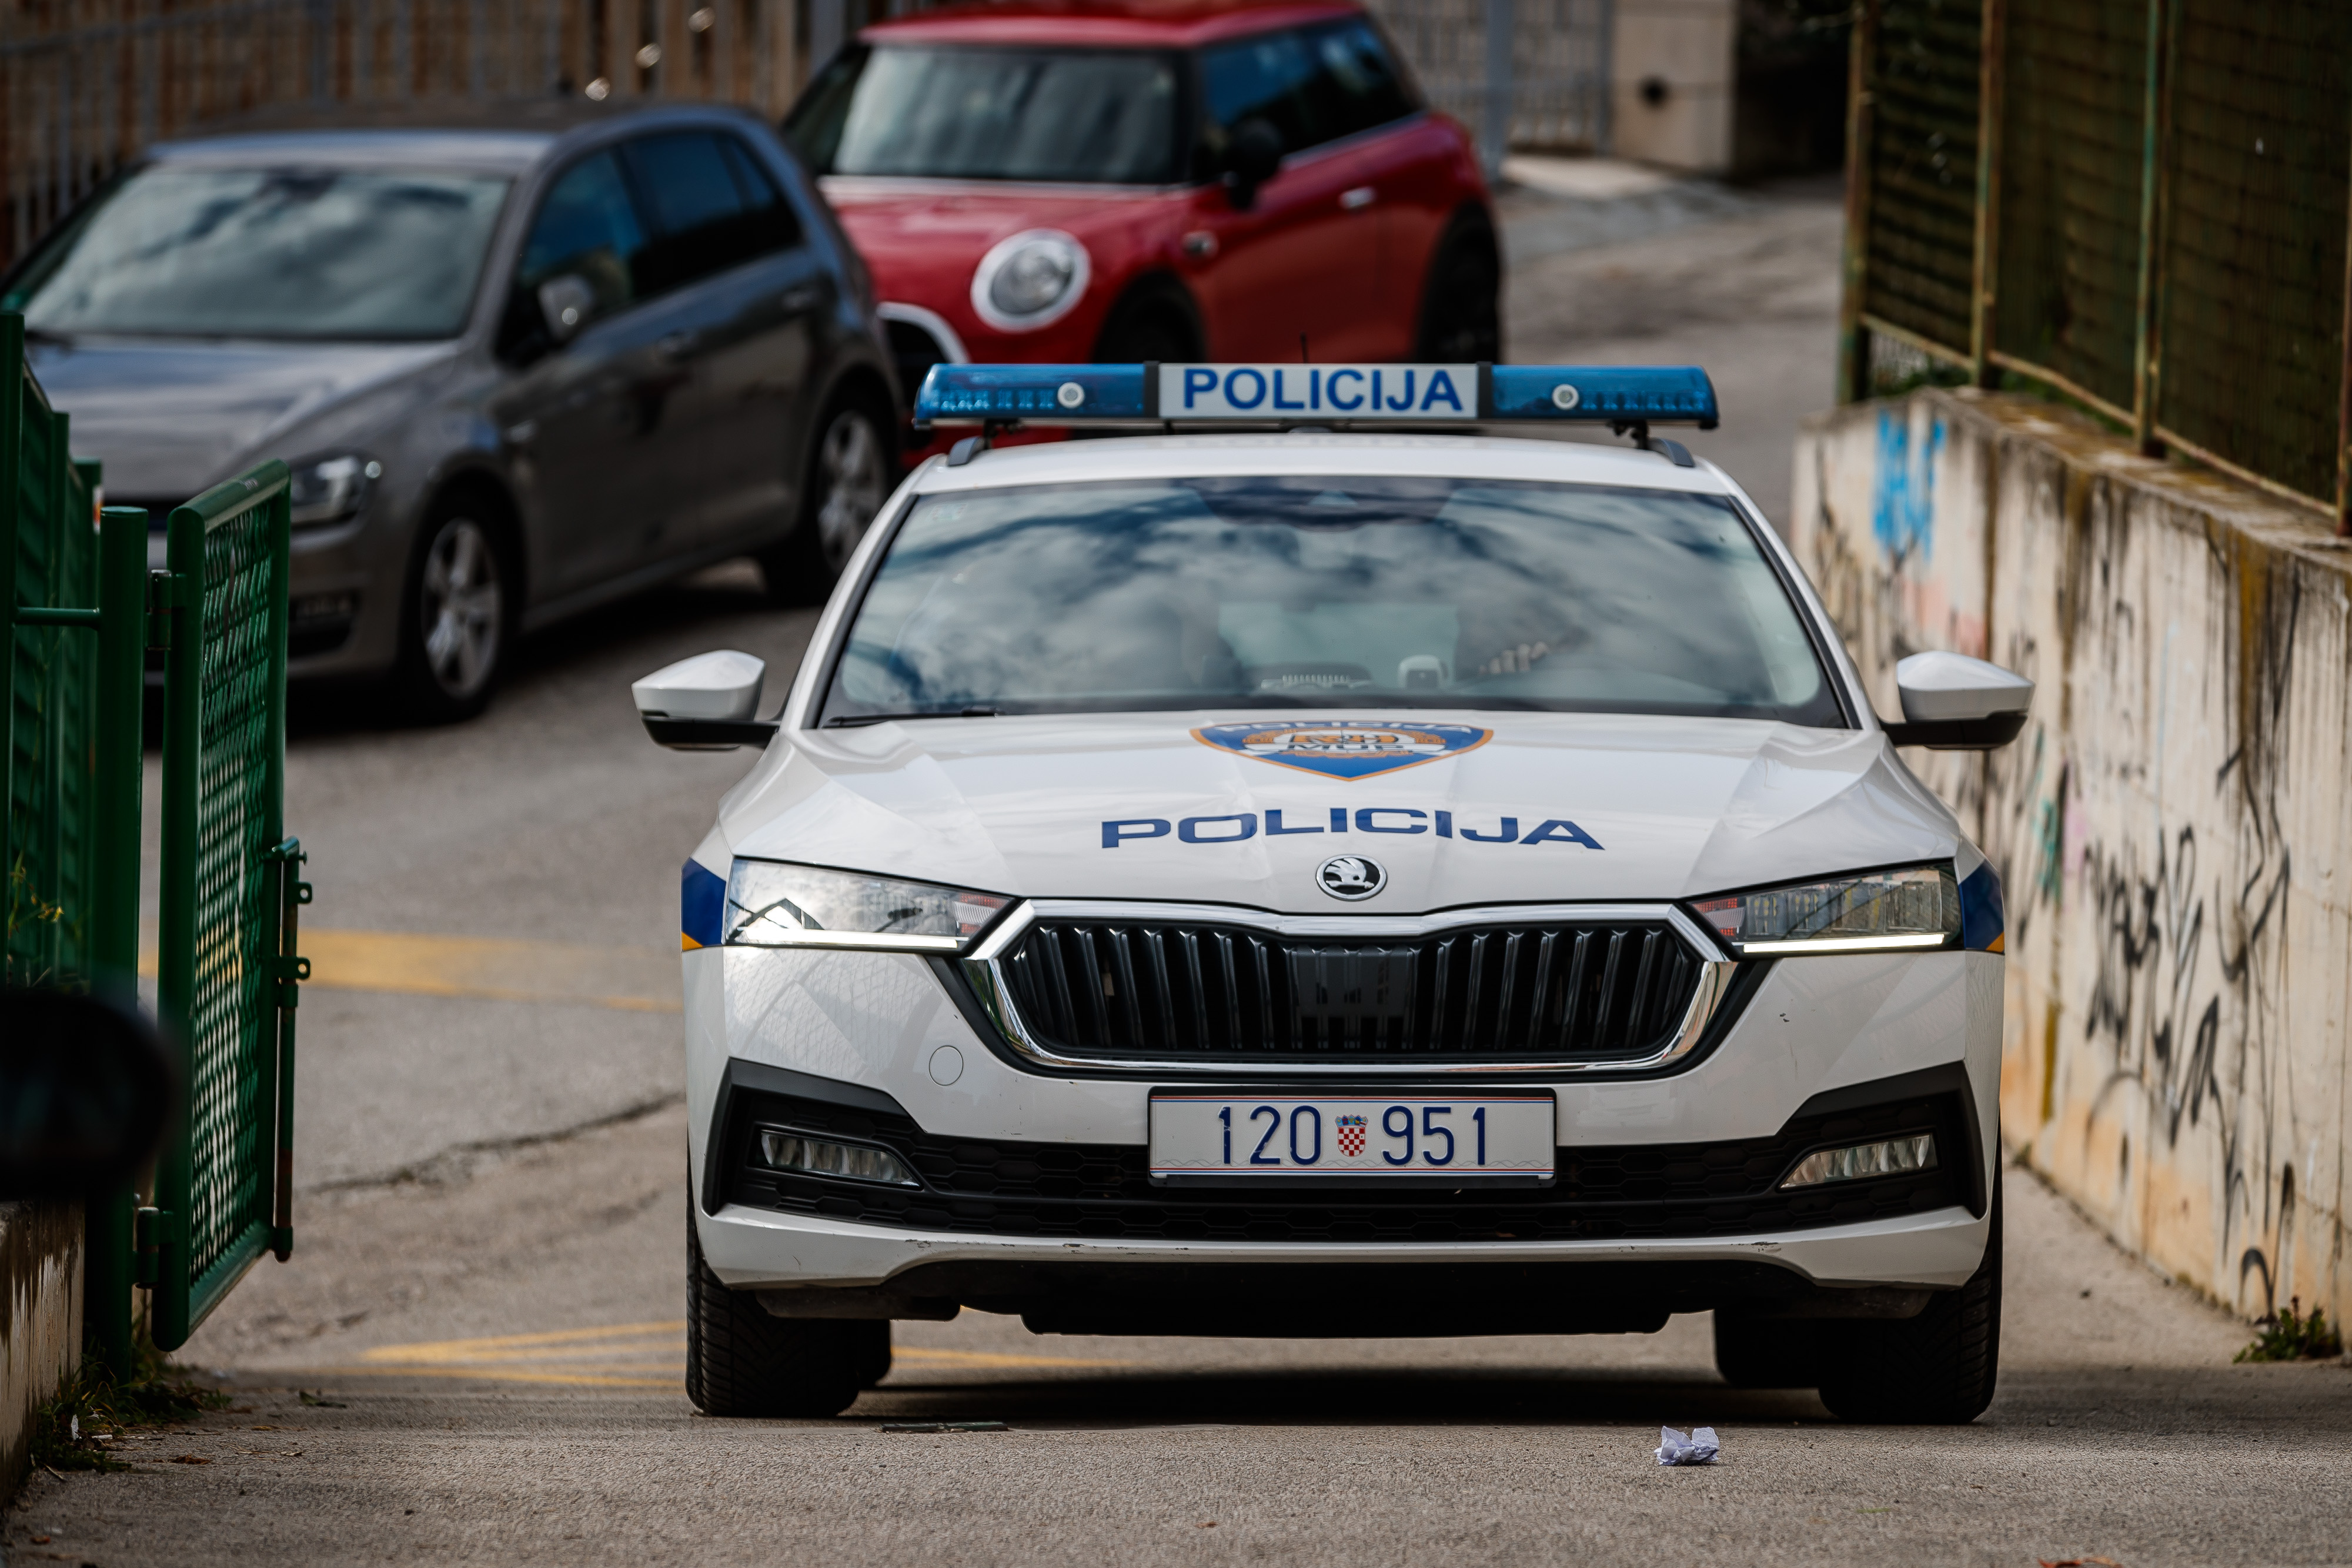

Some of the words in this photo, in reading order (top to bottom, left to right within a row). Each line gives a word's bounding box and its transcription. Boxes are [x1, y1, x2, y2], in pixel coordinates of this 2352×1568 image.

[1184, 369, 1463, 411] POLICIJA
[1214, 721, 1473, 734] POLICIJA
[1101, 807, 1606, 850] POLICIJA
[1218, 1105, 1321, 1166] 120
[1381, 1105, 1485, 1166] 951
